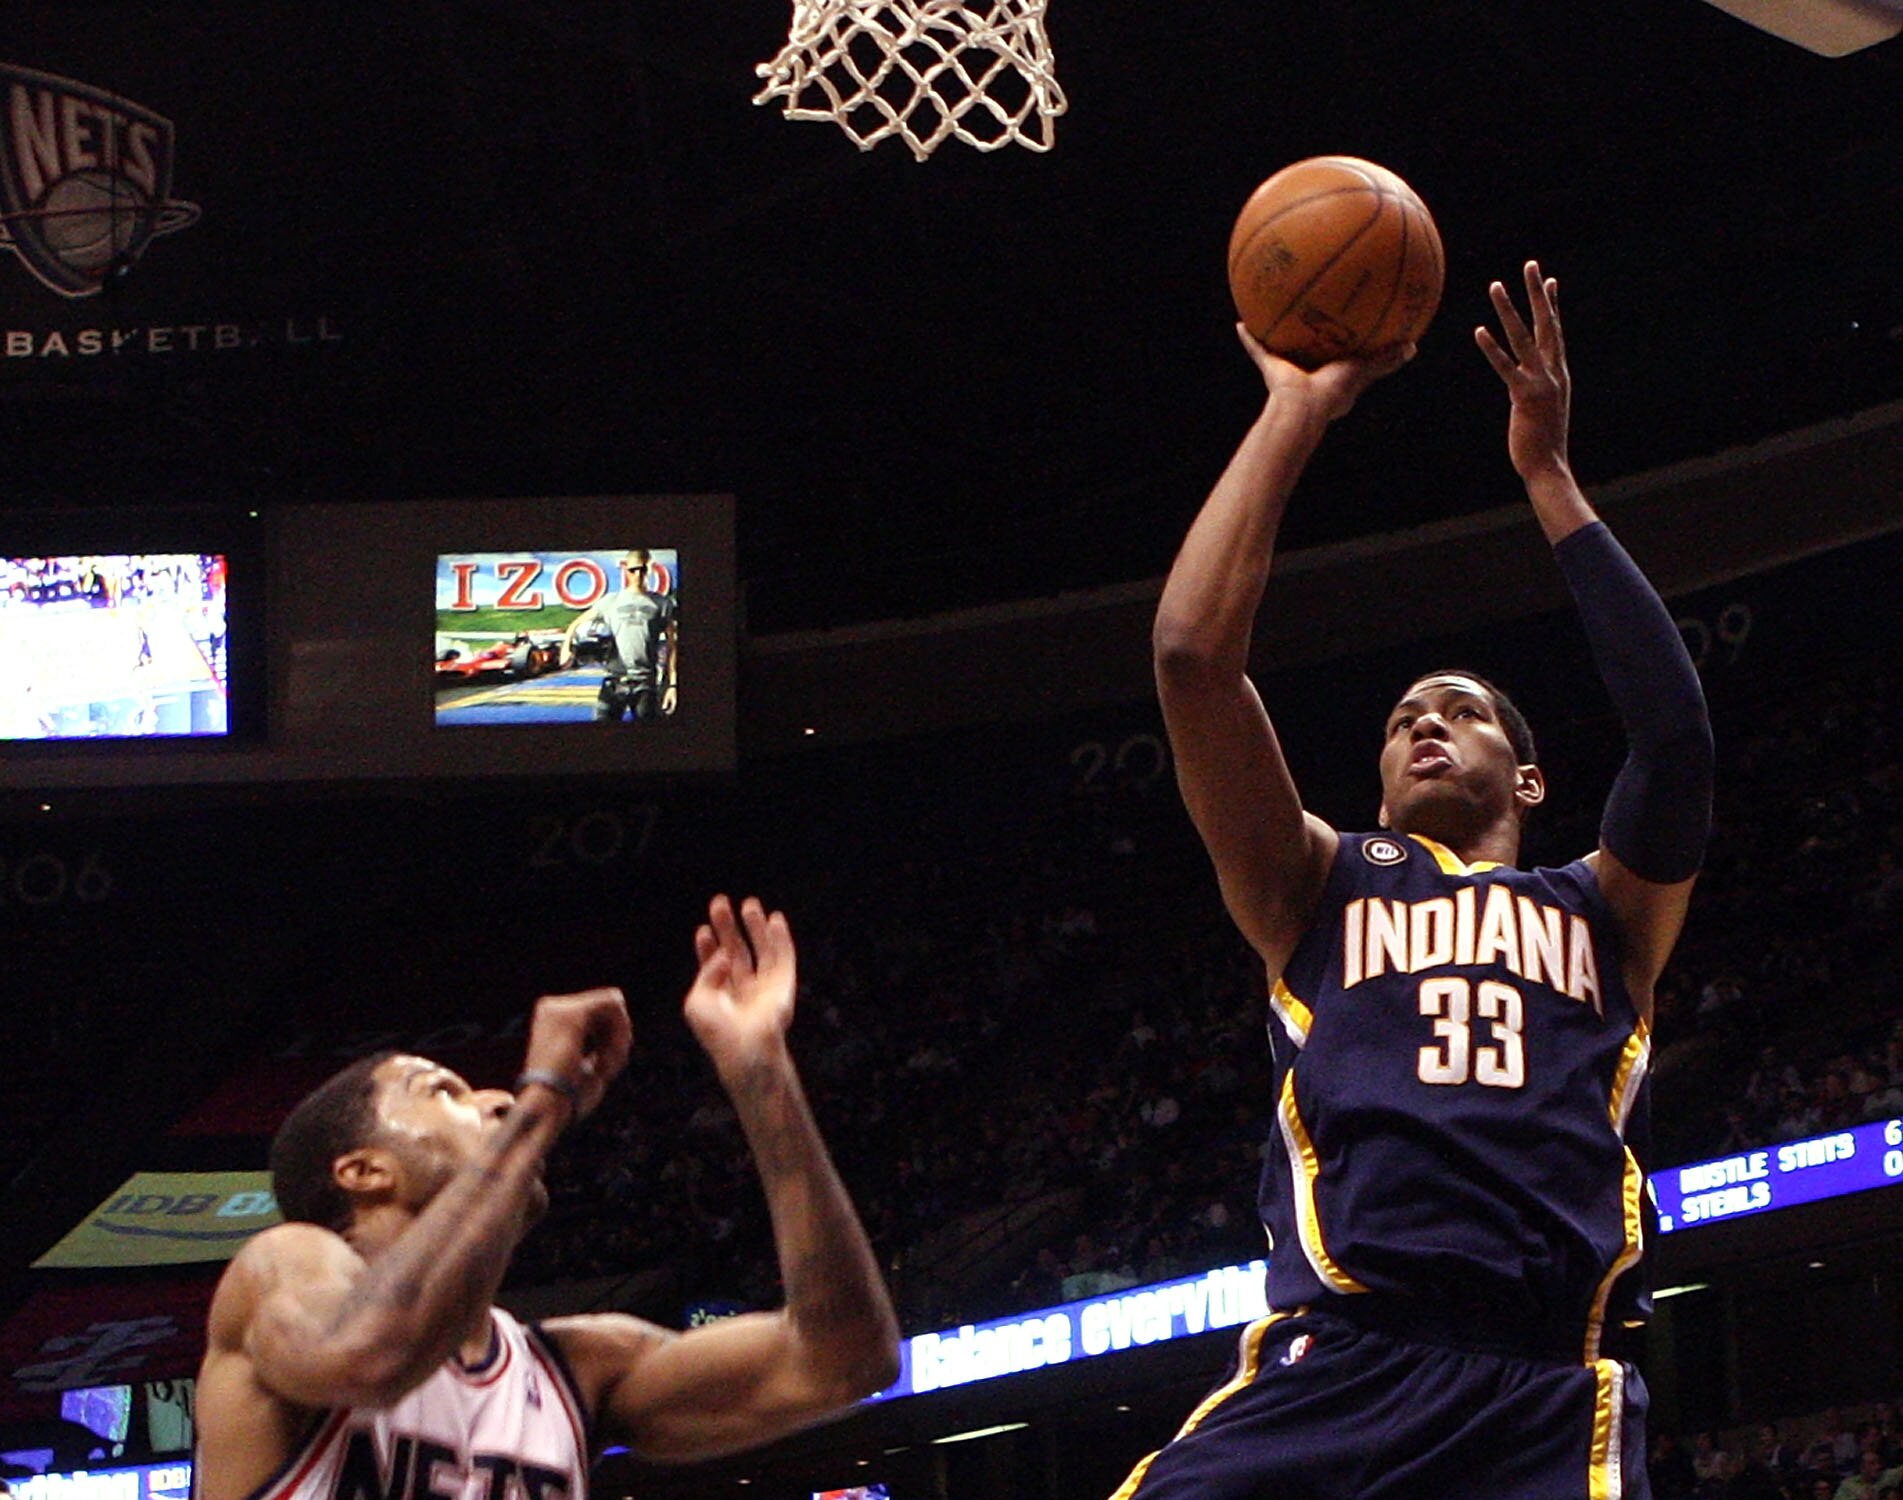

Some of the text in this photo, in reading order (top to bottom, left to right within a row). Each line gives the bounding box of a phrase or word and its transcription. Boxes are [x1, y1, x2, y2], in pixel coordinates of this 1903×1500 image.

[9, 83, 157, 201] NETS
[1342, 884, 1605, 1021] INDIANA
[1417, 976, 1526, 1089] 33
[911, 1320, 1072, 1393] Balance
